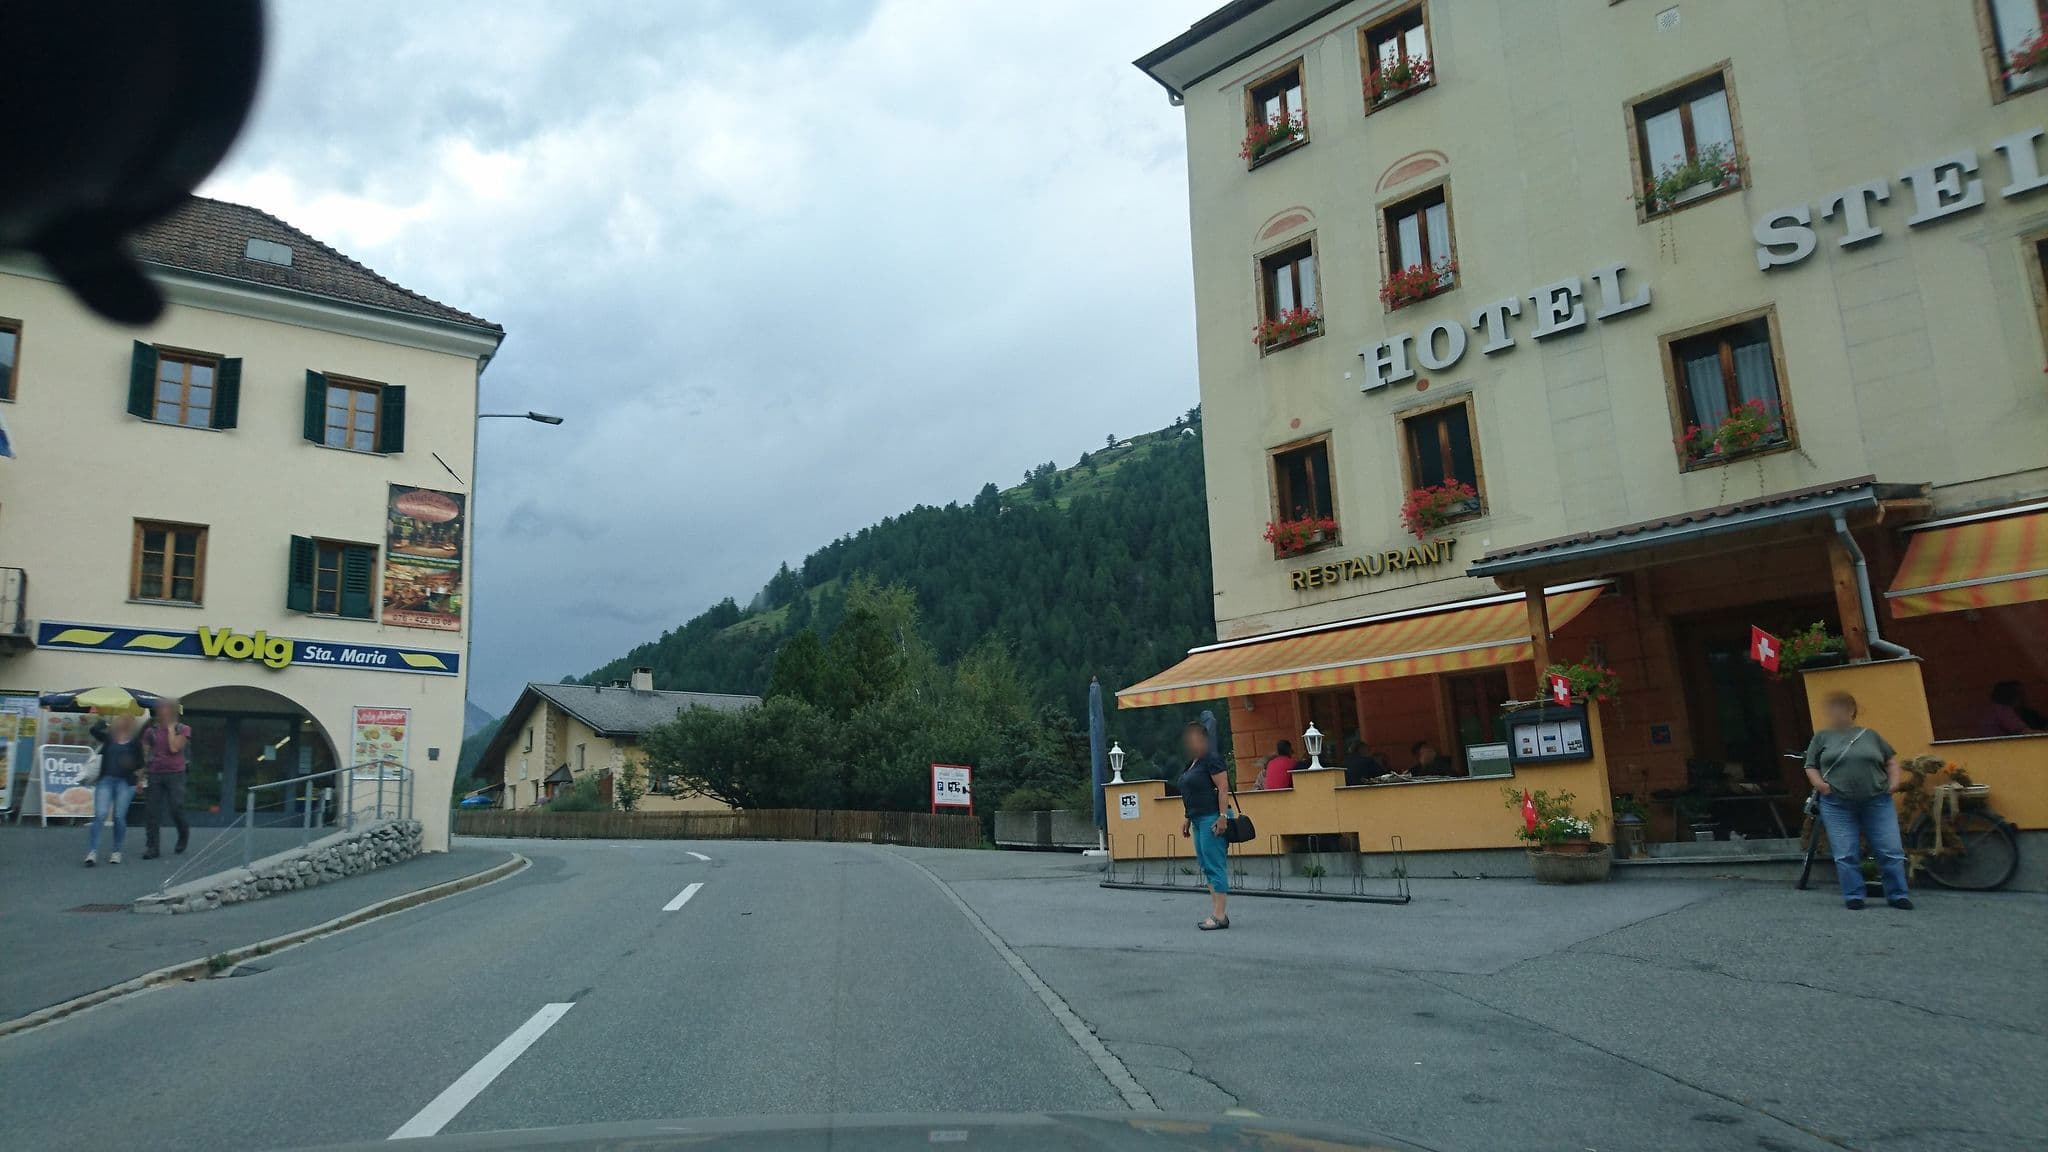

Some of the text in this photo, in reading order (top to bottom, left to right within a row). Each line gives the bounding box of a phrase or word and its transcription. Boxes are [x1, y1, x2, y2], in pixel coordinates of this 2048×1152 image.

[1358, 264, 1651, 393] HOTEL
[1290, 538, 1457, 591] RESTAURANT
[198, 626, 387, 669] Volg Sta. Maria
